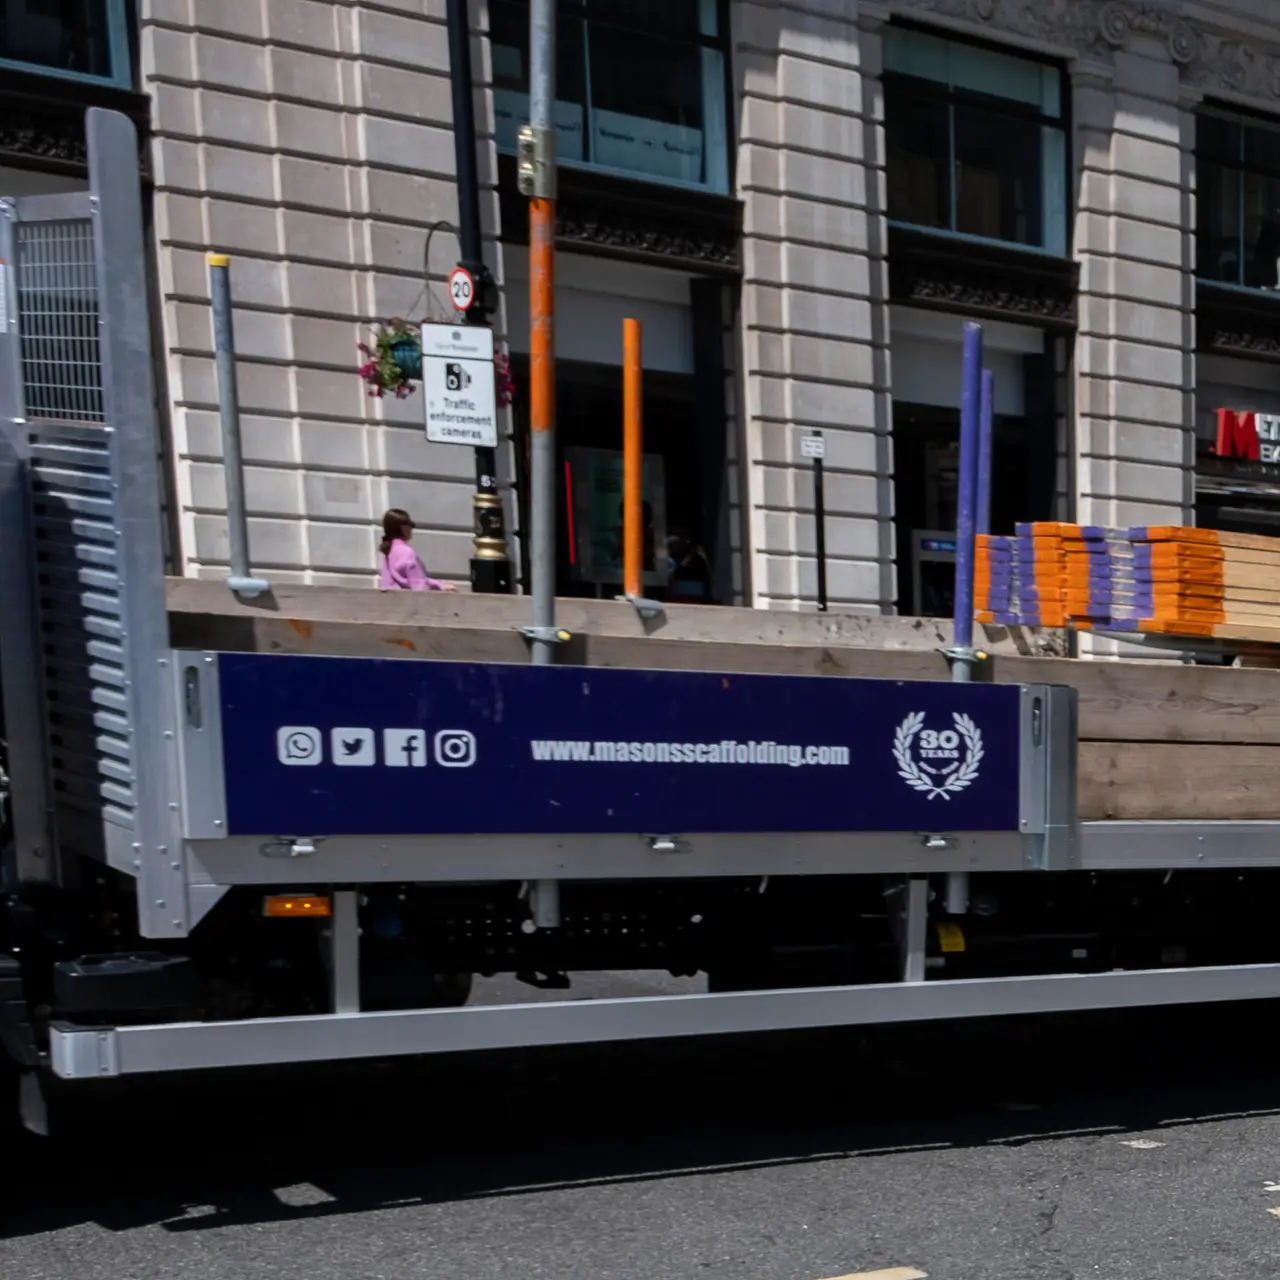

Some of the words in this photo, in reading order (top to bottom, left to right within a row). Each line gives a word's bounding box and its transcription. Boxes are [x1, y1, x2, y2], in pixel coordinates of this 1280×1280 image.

[453, 281, 469, 298] 20
[443, 397, 476, 411] Traffic
[429, 412, 492, 426] enforcement
[441, 427, 483, 439] cameras
[919, 729, 960, 749] 30
[531, 740, 850, 768] www.masonsscaffolding.com
[919, 749, 960, 758] YEARS
